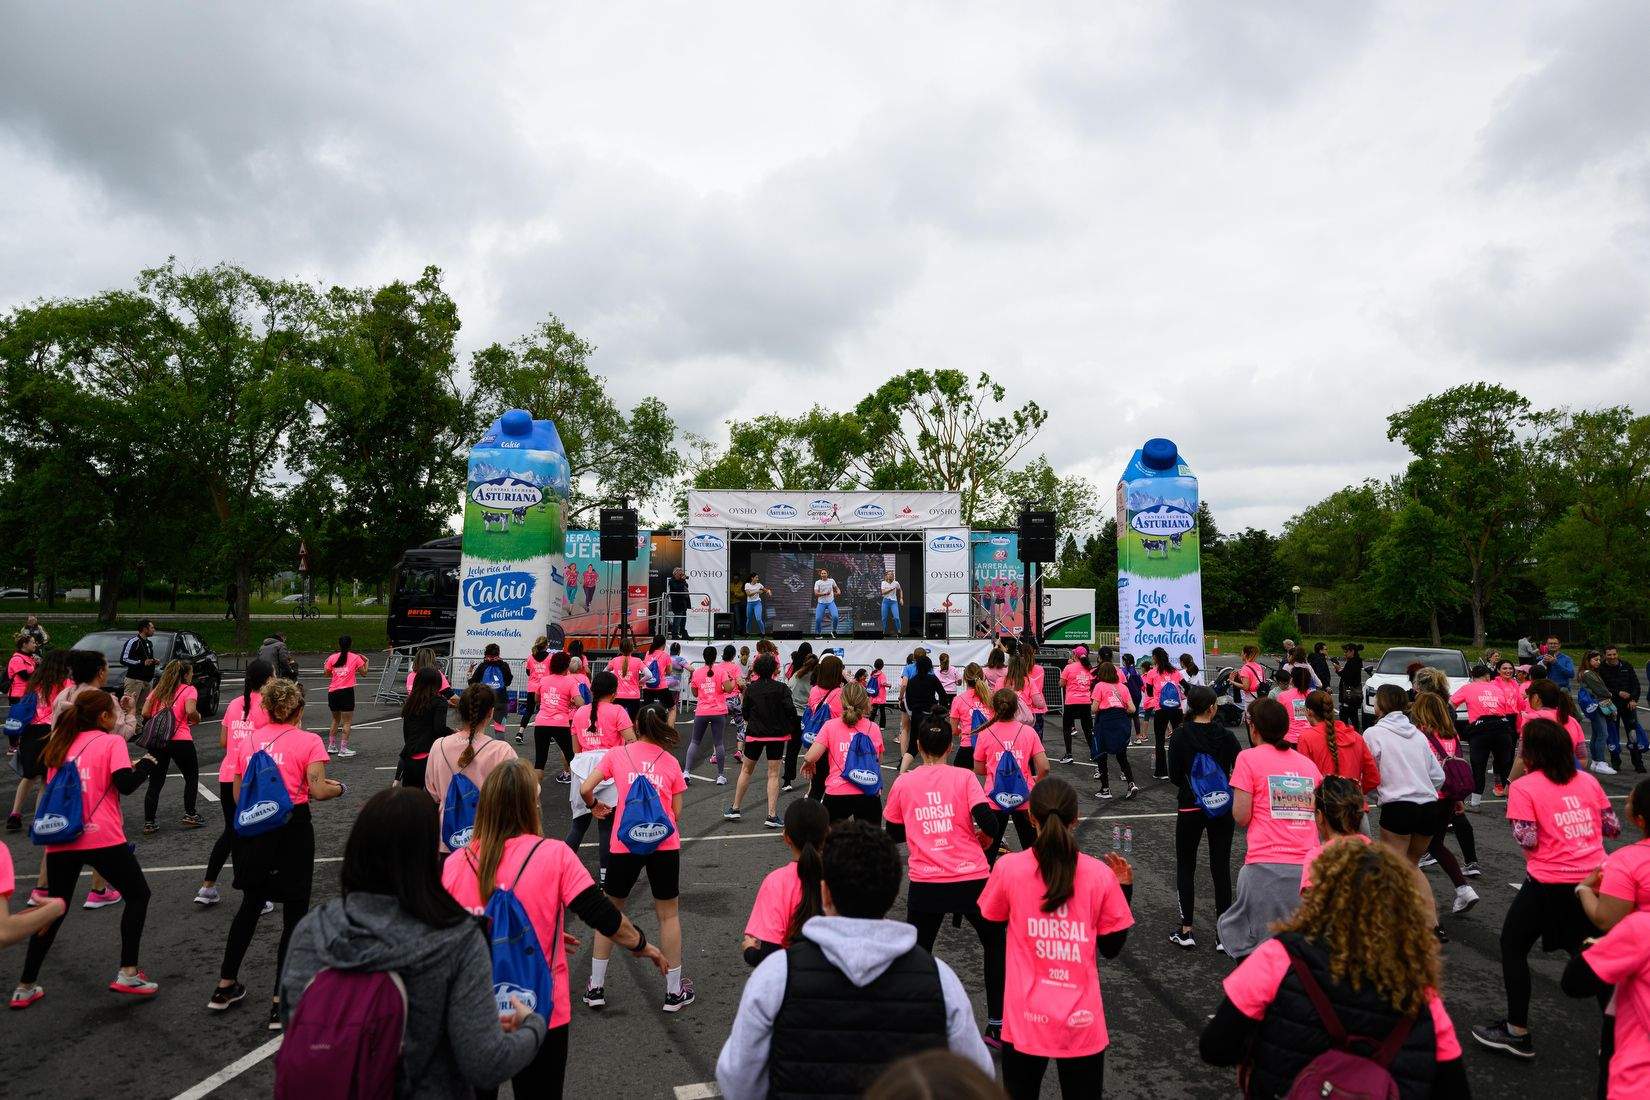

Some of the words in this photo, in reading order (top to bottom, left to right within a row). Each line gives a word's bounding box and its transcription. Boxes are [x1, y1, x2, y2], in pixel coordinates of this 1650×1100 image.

[475, 488, 537, 502] ASTURIANA
[728, 507, 757, 515] OYSHO
[929, 507, 957, 515] OYSHO
[1135, 516, 1190, 529] ASTURIANA
[691, 540, 722, 548] ASTURIANA
[932, 540, 963, 548] ASTURIANA
[468, 566, 484, 577] Leche
[690, 569, 723, 578] OYSHO
[931, 570, 964, 579] OYSHO
[467, 578, 527, 607] Calcio
[1136, 589, 1168, 608] Leche
[491, 607, 524, 619] natural
[1133, 603, 1195, 630] semi
[466, 628, 522, 638] semidesnatada
[1134, 627, 1197, 645] desnatada
[925, 791, 942, 805] TU
[1562, 795, 1580, 809] TU
[914, 803, 956, 821] DORSAL
[922, 818, 954, 835] SUMA
[1027, 917, 1089, 942] DORSAL
[1035, 940, 1082, 963] SUMA
[1048, 968, 1070, 981] 2024
